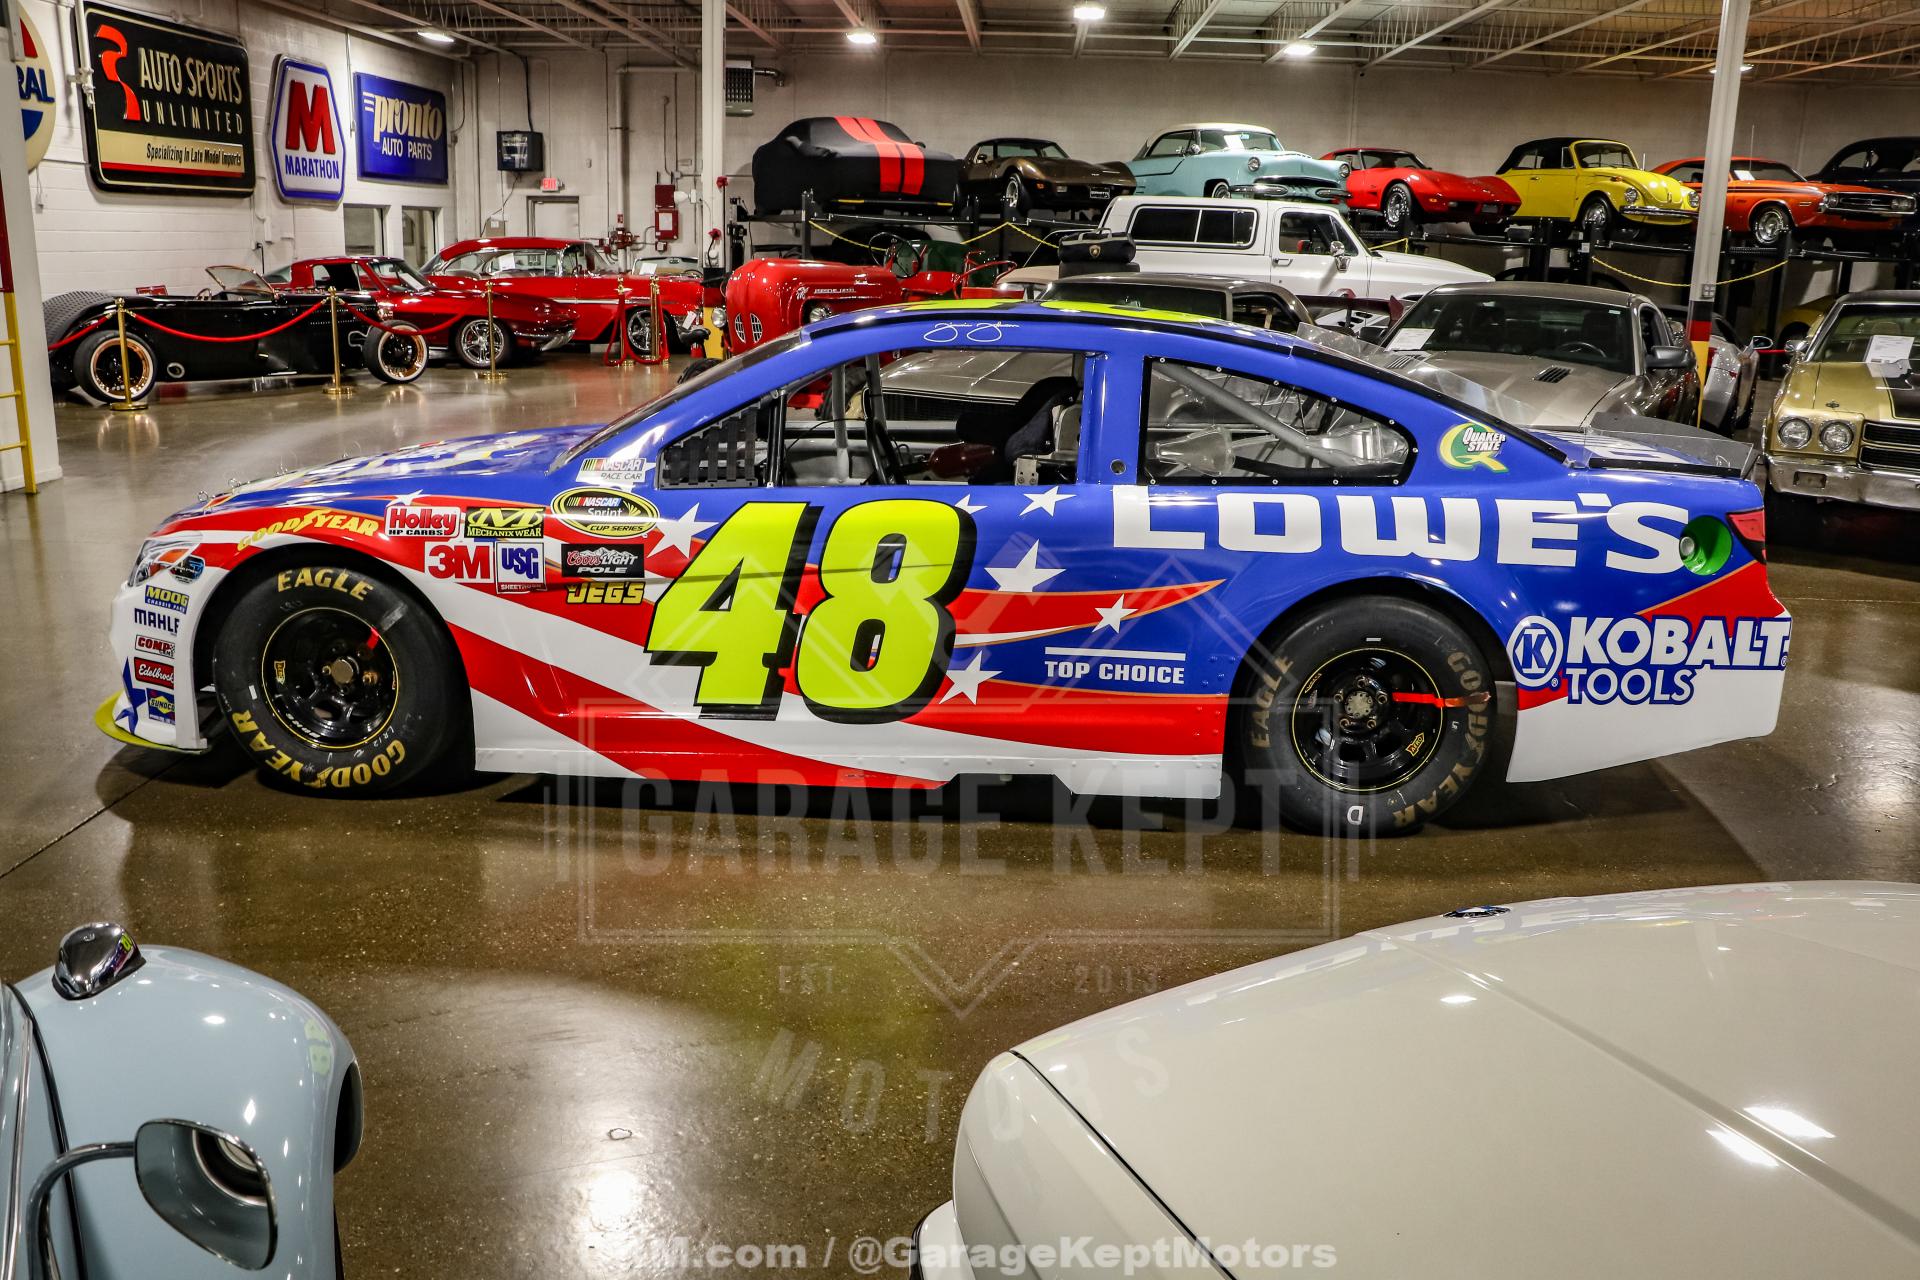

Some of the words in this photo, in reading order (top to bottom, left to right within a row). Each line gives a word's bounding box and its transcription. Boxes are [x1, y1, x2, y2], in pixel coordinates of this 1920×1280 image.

[138, 47, 182, 95] AUTO
[186, 57, 243, 104] SPORTS
[142, 99, 243, 134] UNLIMITED
[285, 79, 337, 155] M
[373, 94, 443, 143] pronto
[146, 142, 183, 164] Specializing
[191, 147, 203, 163] Late
[203, 148, 221, 164] Model
[381, 136, 404, 156] AUTO
[407, 140, 433, 161] PARTS
[285, 154, 340, 180] MARATHON
[1462, 427, 1506, 445] QUAKER
[1467, 441, 1502, 452] STATE
[599, 459, 642, 471] NASCAR
[583, 497, 622, 507] NASCAR
[587, 507, 622, 518] Sprint
[237, 508, 379, 551] GOODYEAR
[389, 508, 457, 535] Holley
[467, 526, 514, 537] MECHANIX
[514, 526, 542, 537] WEAR
[1112, 484, 1689, 574] LOWE'S
[428, 544, 491, 579] 3M
[501, 547, 540, 580] USG
[566, 551, 601, 565] Coors
[600, 555, 639, 565] LIGHT
[576, 566, 628, 574] POLE
[146, 586, 189, 607] MOOG
[277, 566, 375, 601] EAGLE
[134, 607, 180, 633] MAHLE
[645, 498, 978, 725] 48
[138, 636, 171, 652] COMP
[1566, 616, 1790, 667] KOBALT
[138, 663, 175, 683] Edelbrock
[1044, 660, 1091, 680] TOP
[1098, 662, 1185, 685] CHOICE
[1567, 668, 1695, 701] TOOLS
[150, 698, 176, 711] SUNOCO
[1252, 655, 1294, 748] EAGLE
[232, 709, 407, 789] GOODYEAR
